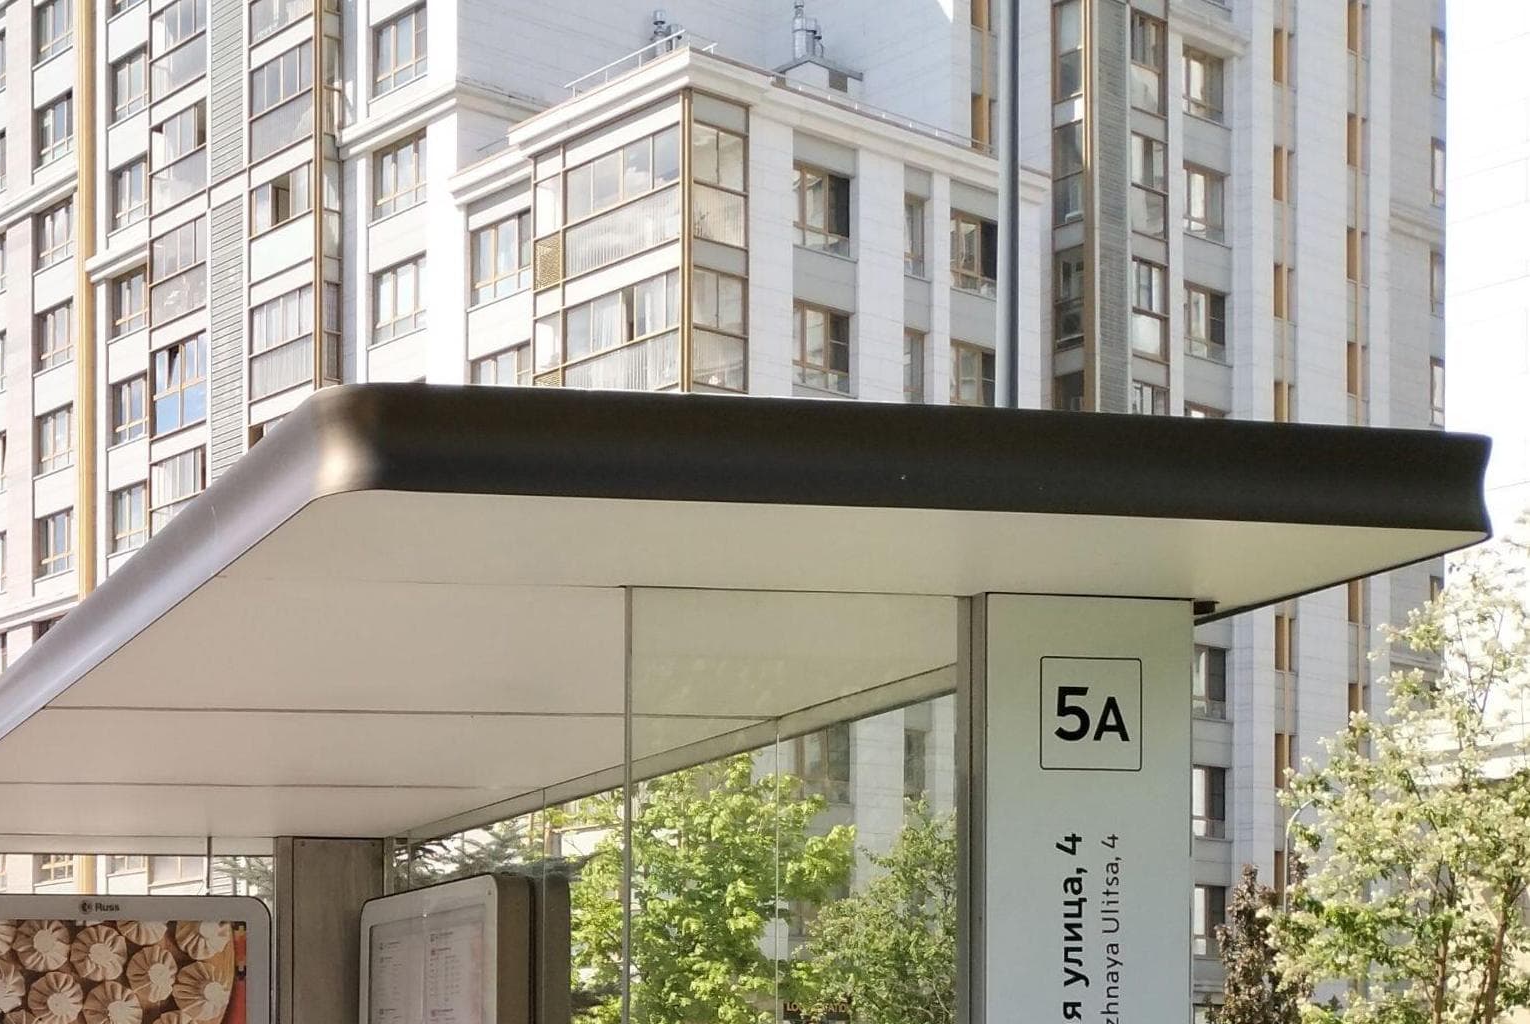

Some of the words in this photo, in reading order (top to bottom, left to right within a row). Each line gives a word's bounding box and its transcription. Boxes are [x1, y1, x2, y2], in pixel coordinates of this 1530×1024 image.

[1055, 832, 1083, 856] 4
[1101, 833, 1119, 849] 4
[1100, 857, 1122, 934] Ulitsa,
[1063, 867, 1090, 988] улица,
